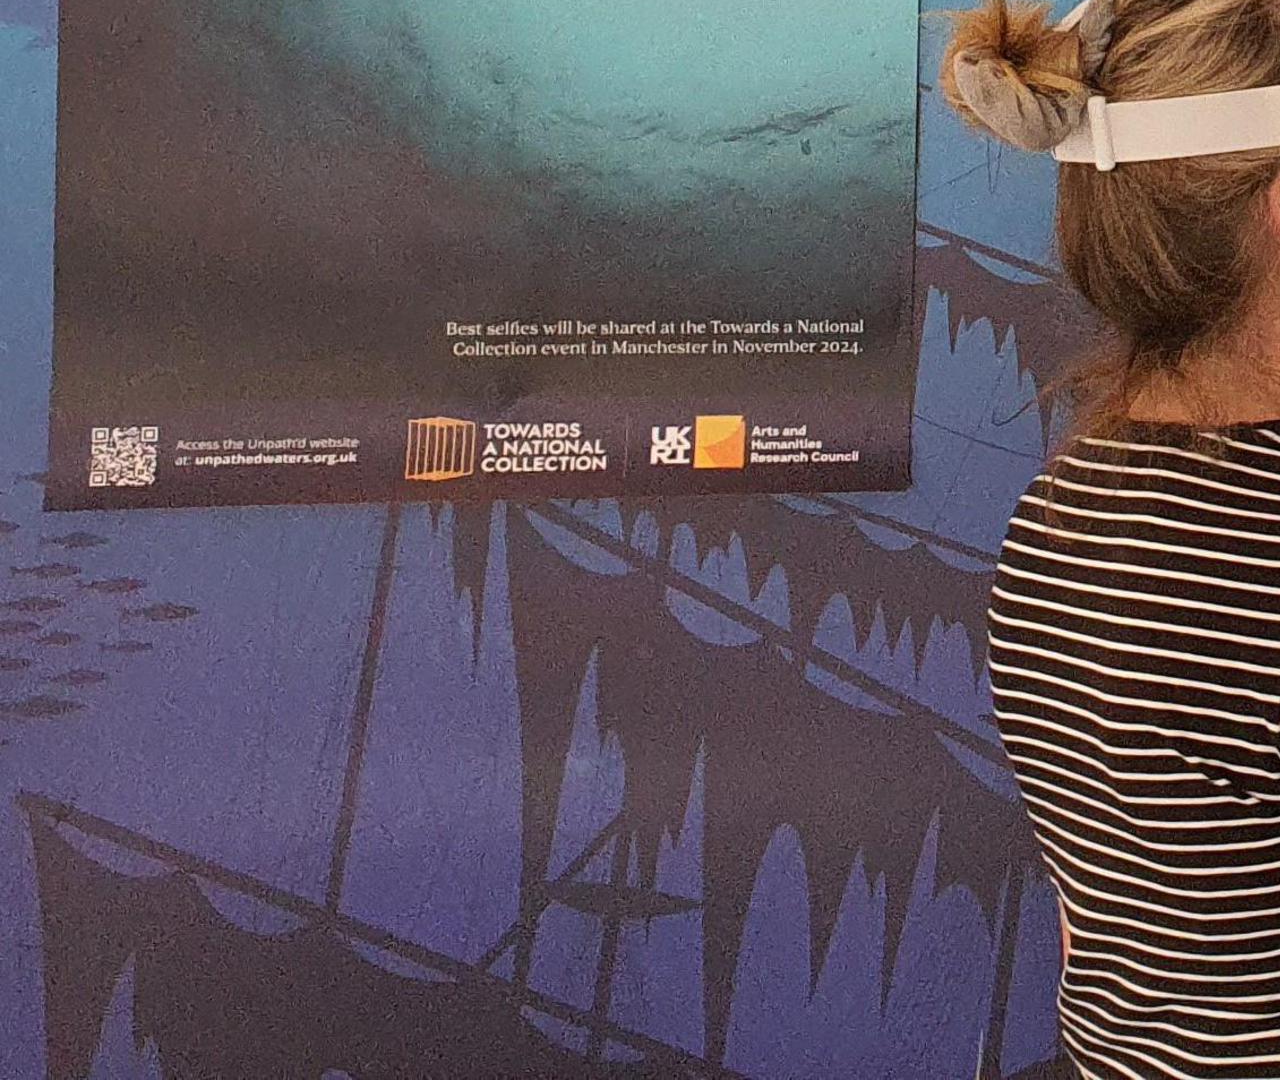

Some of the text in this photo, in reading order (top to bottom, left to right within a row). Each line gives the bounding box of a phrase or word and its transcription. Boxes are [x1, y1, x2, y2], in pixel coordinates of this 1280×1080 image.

[446, 319, 864, 336] Best selfies will be shared at the Towards a National
[453, 339, 863, 356] Collection event in Manchester in November 2024.
[483, 422, 581, 439] TOWARDS
[651, 426, 692, 448] UK
[751, 425, 807, 437] Arts and
[175, 438, 220, 450] Access
[222, 438, 244, 450] the
[309, 436, 360, 449] website
[482, 439, 605, 456] A NATIONAL
[751, 438, 823, 450] Humanities
[480, 455, 607, 472] COLLECTION
[650, 446, 691, 464] RI
[750, 450, 860, 463] Research Council
